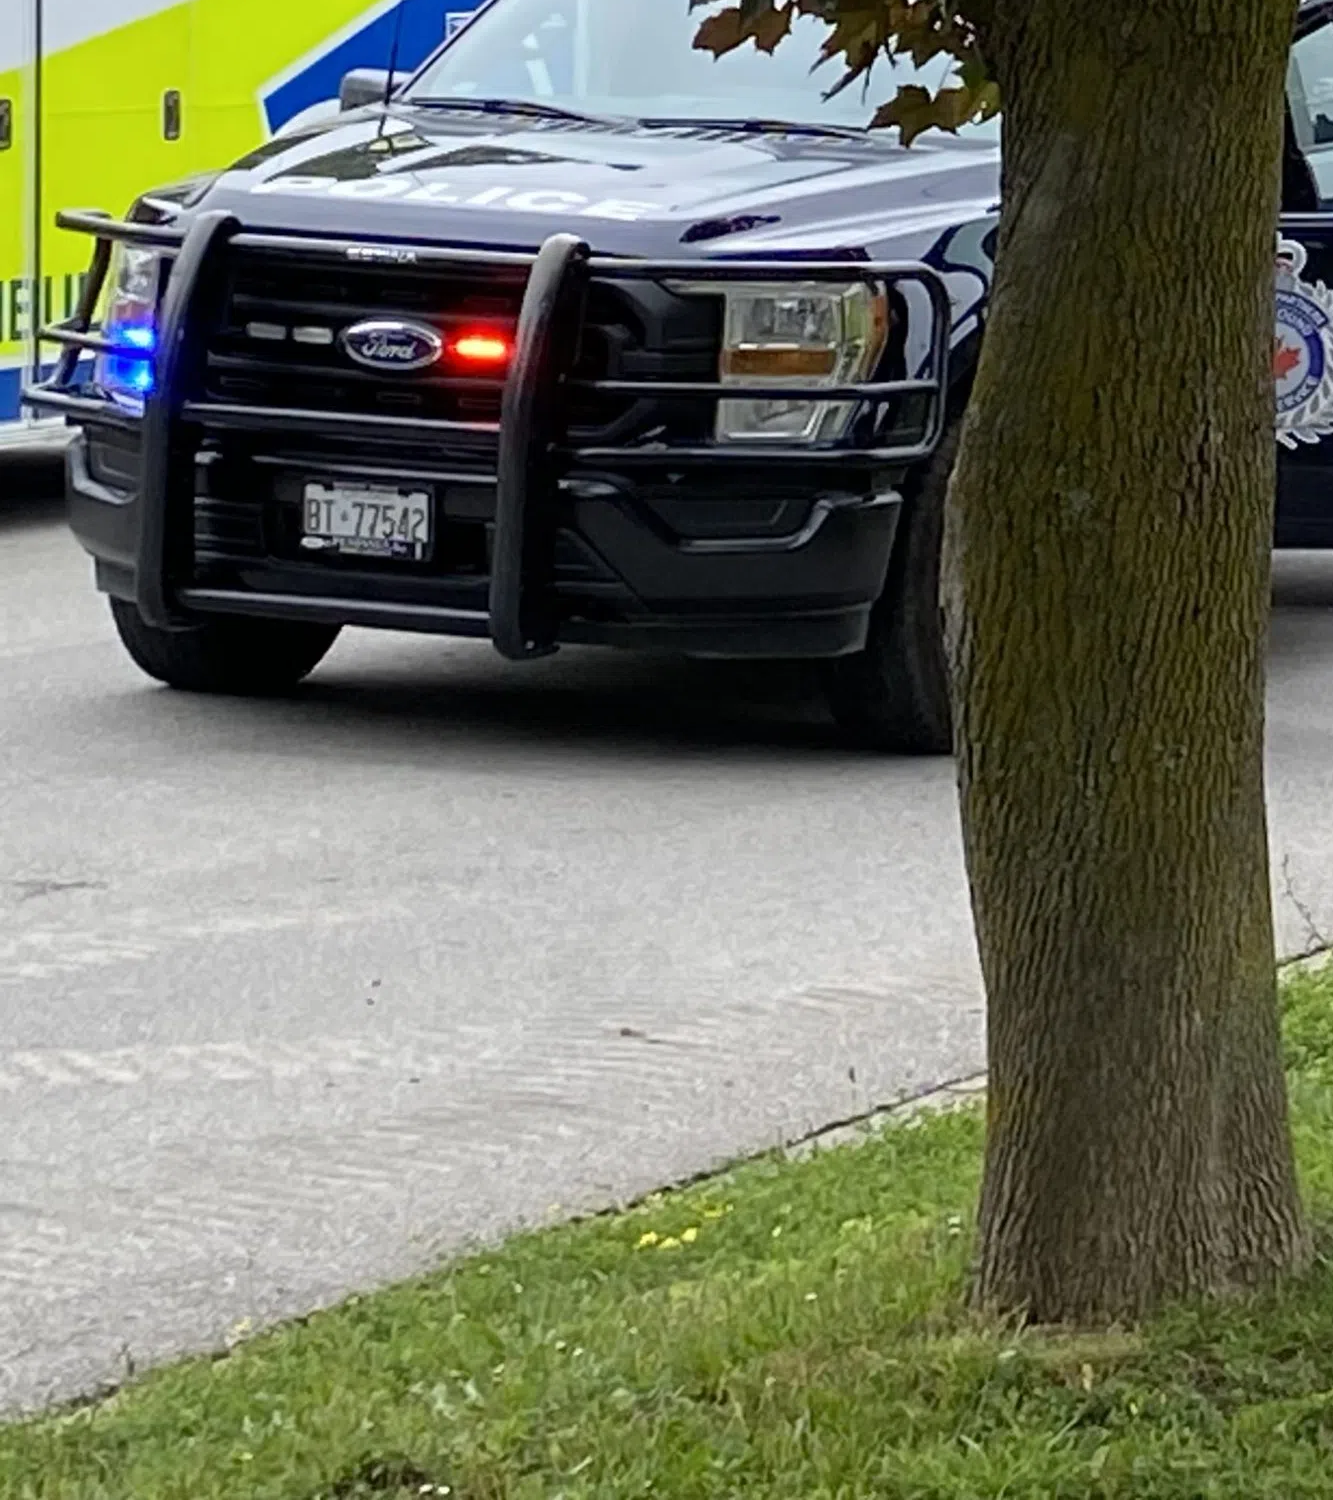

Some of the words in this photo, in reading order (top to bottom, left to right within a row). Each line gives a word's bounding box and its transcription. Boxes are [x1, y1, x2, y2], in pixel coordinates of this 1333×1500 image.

[250, 176, 663, 221] POLICE
[361, 332, 418, 360] Ford
[307, 499, 333, 533] BT
[351, 502, 425, 545] 77542
